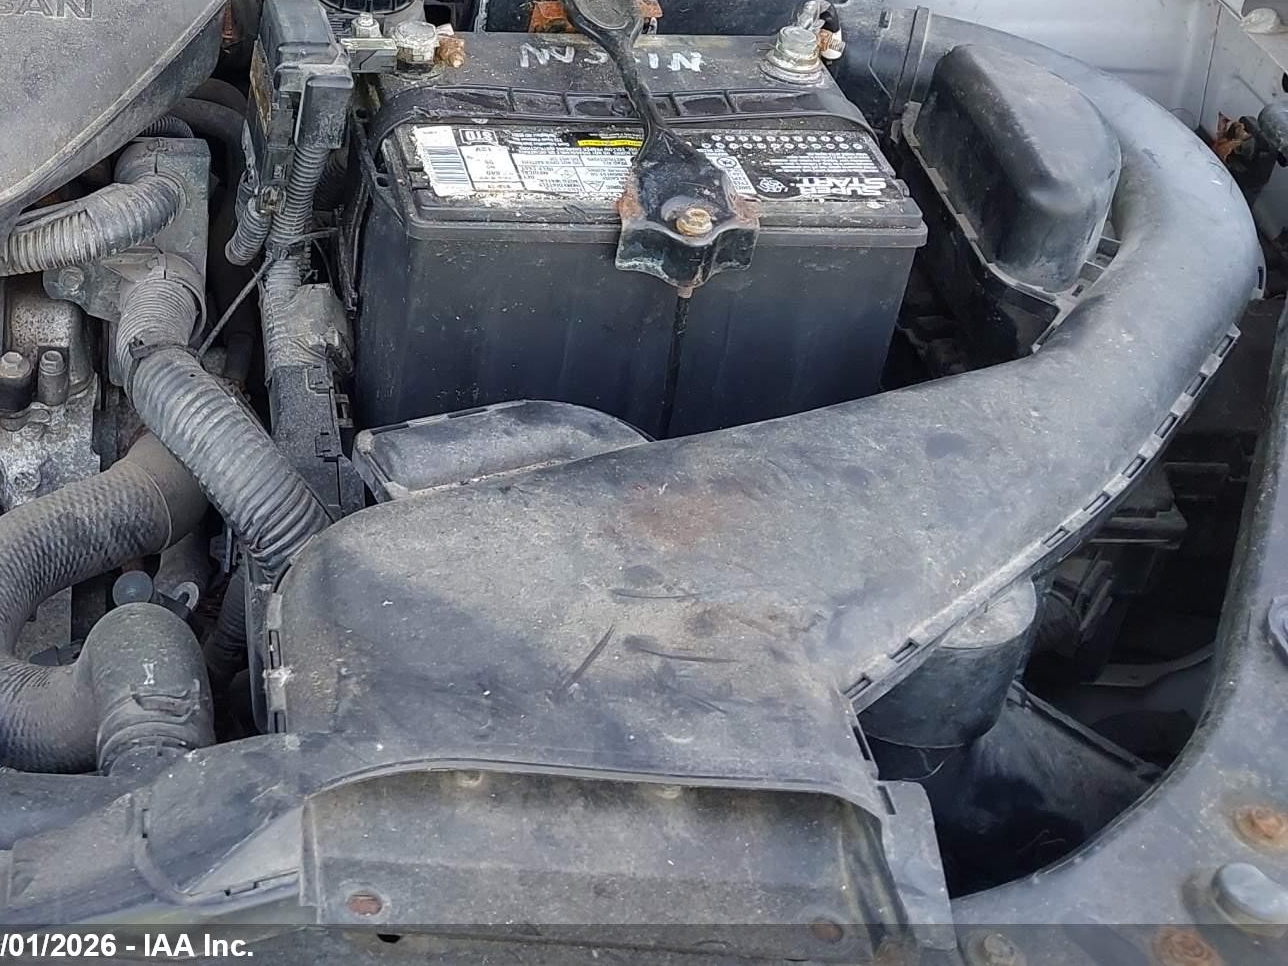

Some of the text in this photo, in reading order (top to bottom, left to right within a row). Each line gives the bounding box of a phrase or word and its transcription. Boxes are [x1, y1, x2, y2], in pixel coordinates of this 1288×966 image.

[519, 43, 705, 72] NISAN
[795, 177, 886, 188] START
[799, 186, 882, 196] SUPER
